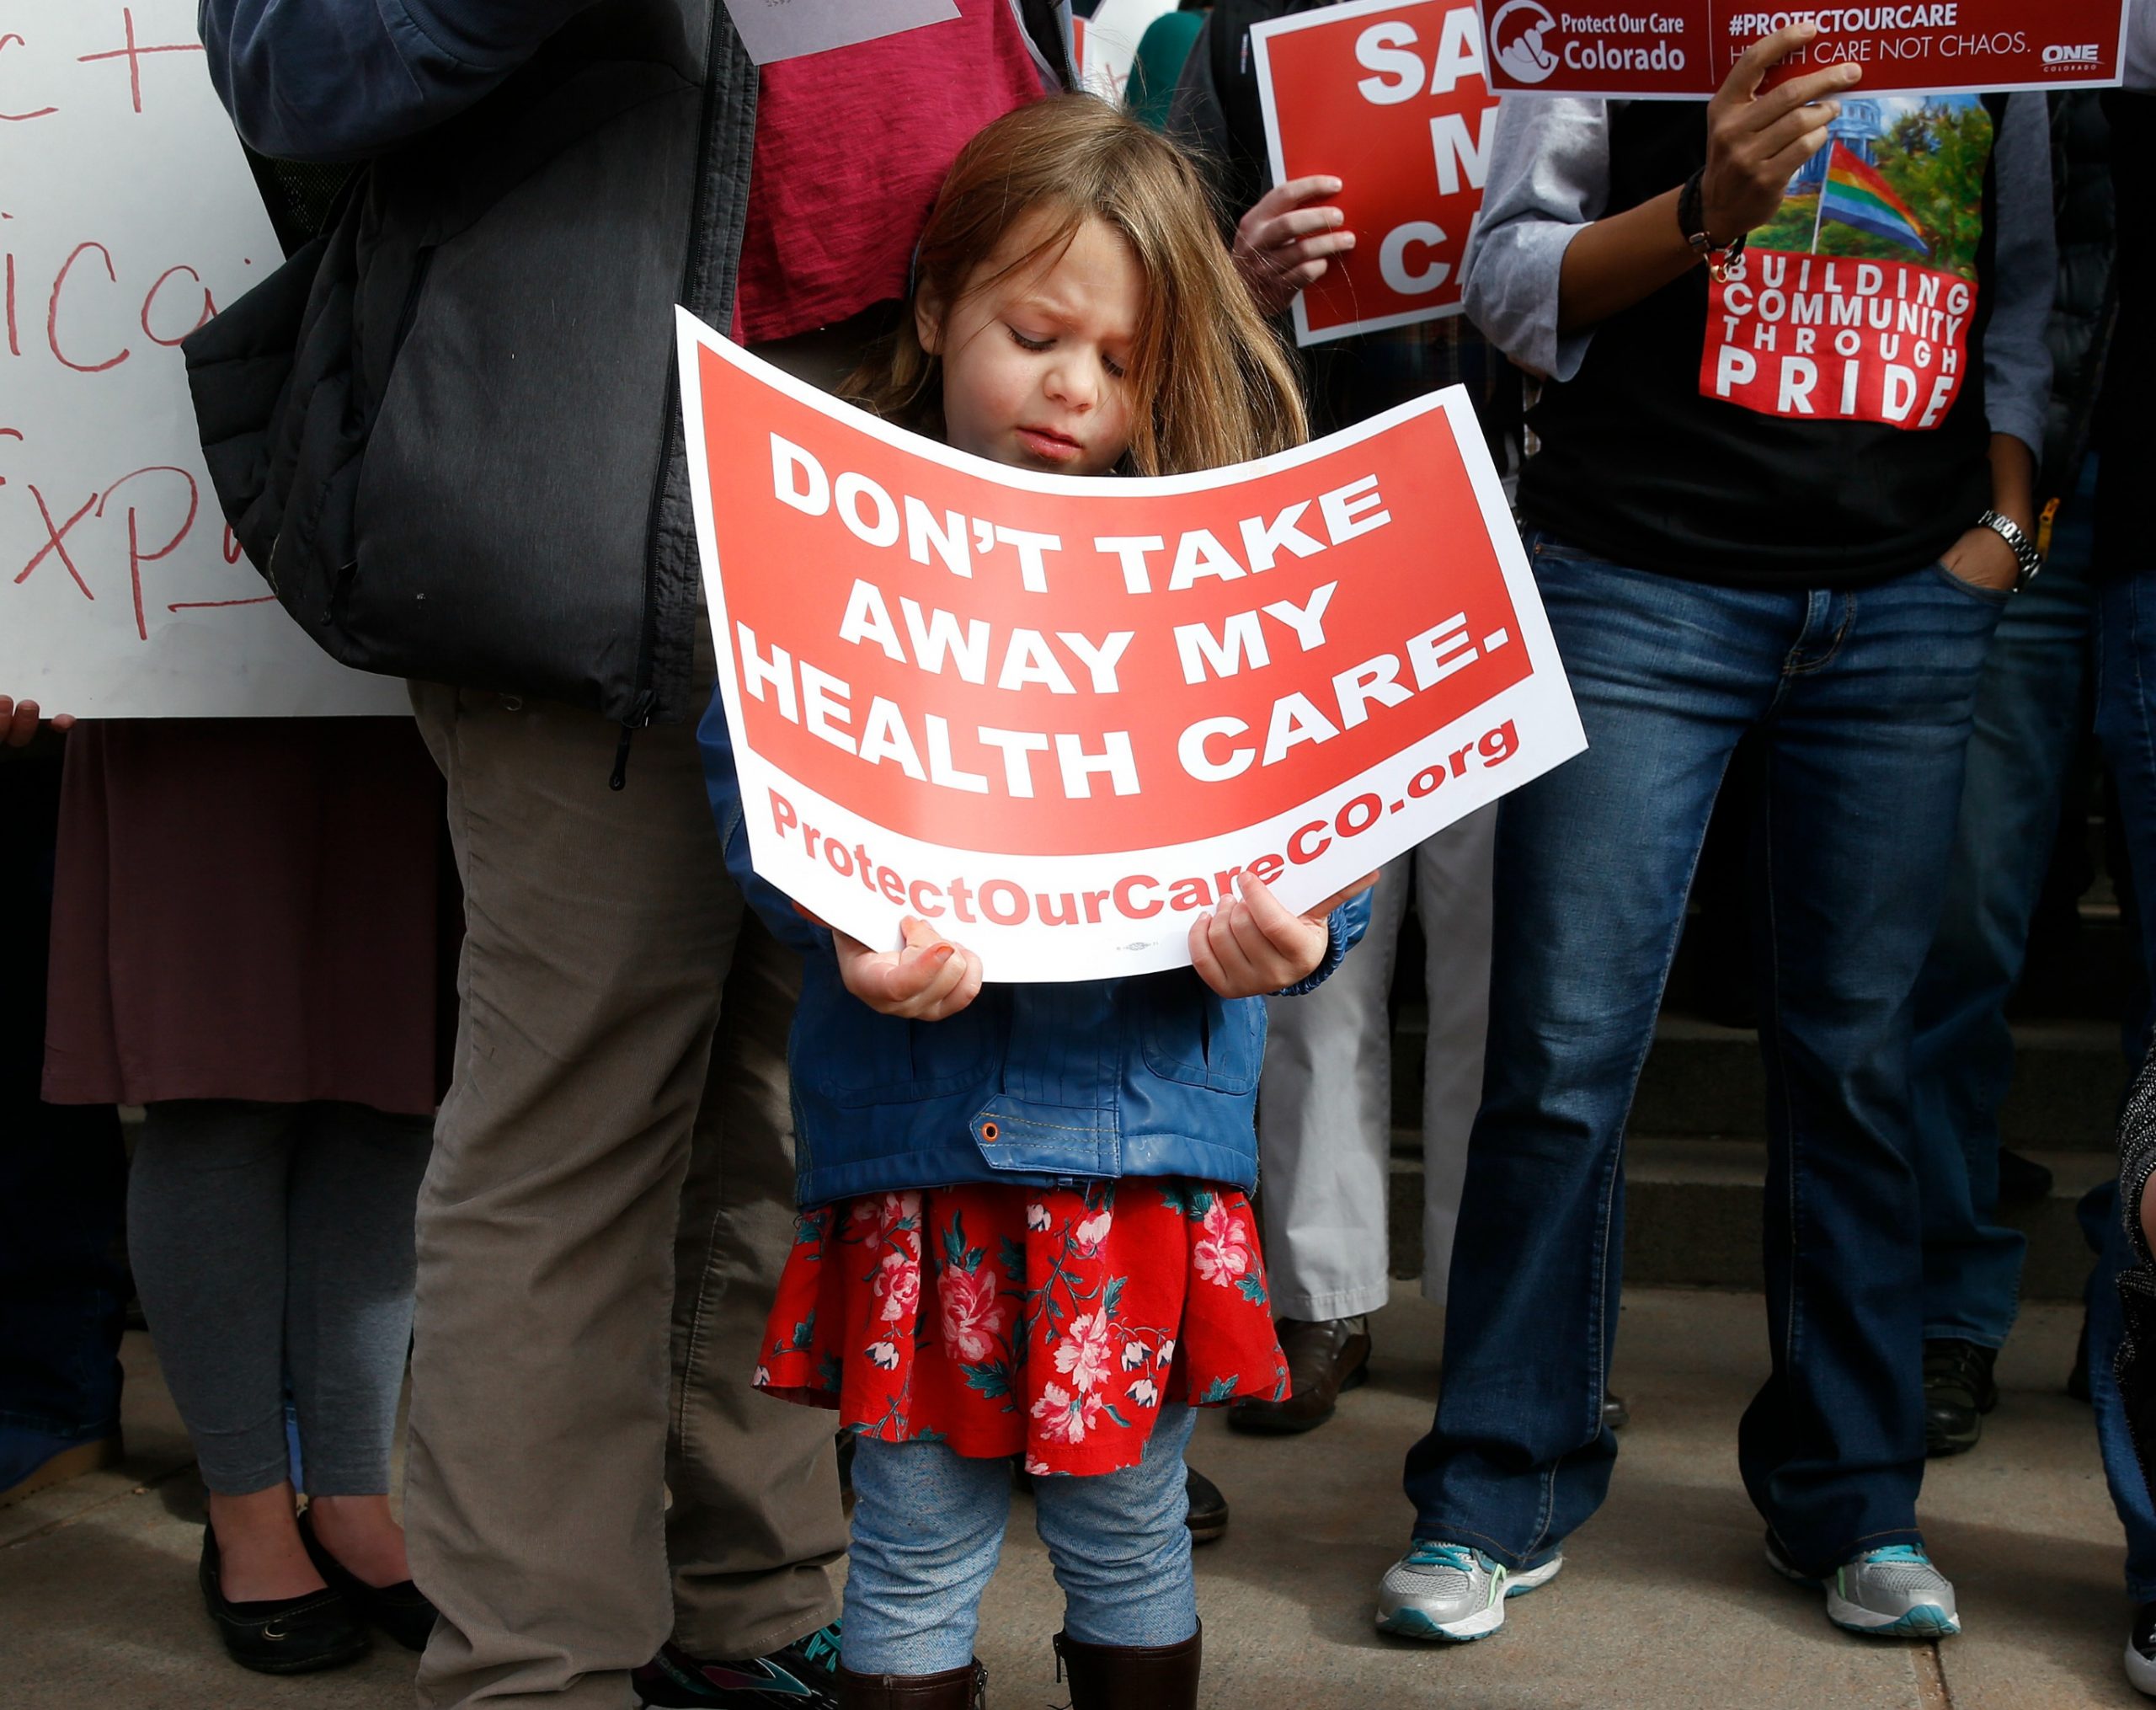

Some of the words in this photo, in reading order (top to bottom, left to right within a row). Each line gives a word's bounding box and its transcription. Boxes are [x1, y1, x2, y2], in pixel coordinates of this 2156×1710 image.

[1561, 13, 1616, 33] Protect
[1619, 13, 1646, 33] Our
[1649, 13, 1684, 33] Care
[1814, 40, 1871, 64] CARE
[1879, 36, 1933, 60] NOT
[1940, 31, 2031, 56] CHAOS.
[2041, 44, 2099, 63] ONE
[1564, 40, 1684, 71] Colorado
[2043, 64, 2096, 72] COLORADO
[1723, 282, 1962, 345] COMMUNITY
[1724, 251, 1969, 315] BUILDING
[1723, 315, 1957, 374] THROUGH
[1716, 344, 1954, 427] PRIDE
[770, 431, 1062, 593] DON'T
[1096, 473, 1392, 594] TAKE
[839, 578, 1134, 695] AWAY
[1172, 580, 1337, 685] MY
[736, 620, 1141, 799] HEALTH
[1177, 612, 1509, 783] CARE.
[767, 719, 1519, 927] ProtectOurCareCO.org
